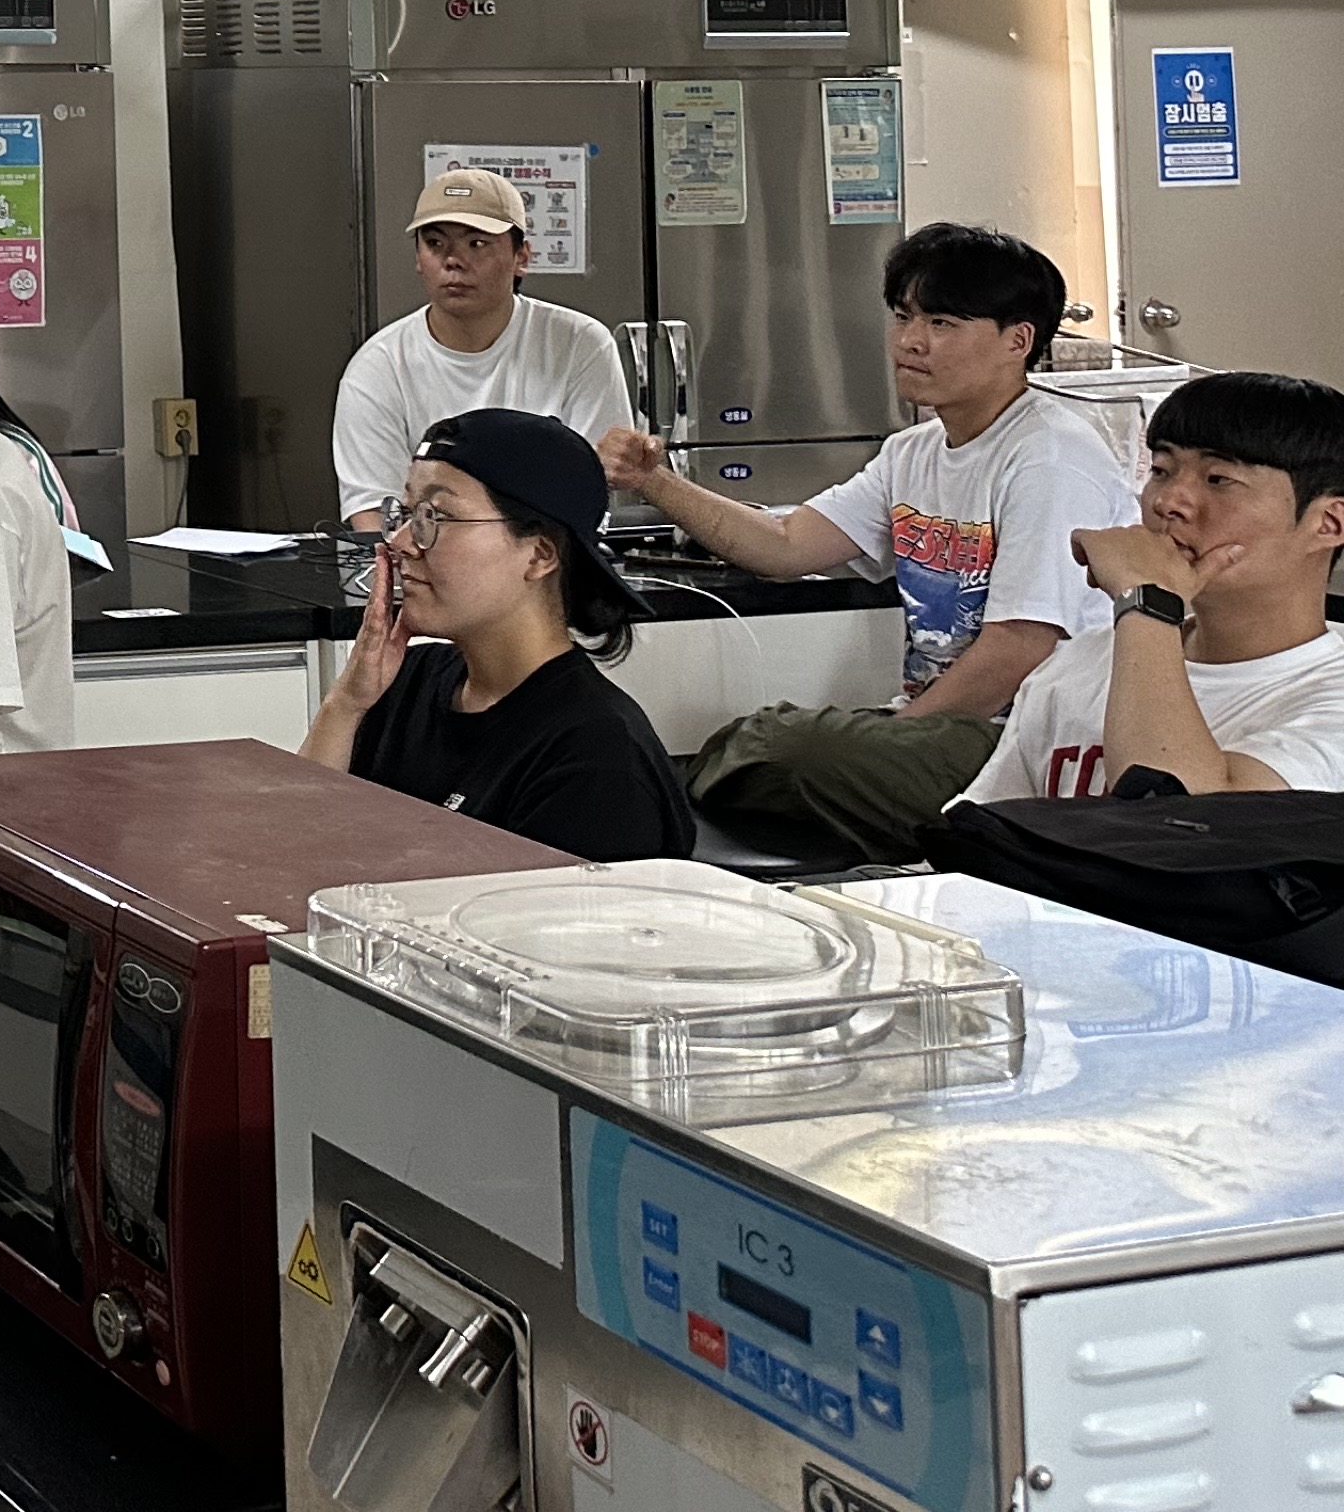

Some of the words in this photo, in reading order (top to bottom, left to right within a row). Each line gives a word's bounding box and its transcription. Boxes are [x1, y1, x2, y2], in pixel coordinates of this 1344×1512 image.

[473, 0, 496, 15] LG
[22, 120, 34, 138] 2
[25, 245, 37, 263] 4
[648, 1217, 669, 1237] SET
[738, 1223, 769, 1265] IC
[777, 1244, 796, 1277] 3
[692, 1329, 720, 1351] STOP
